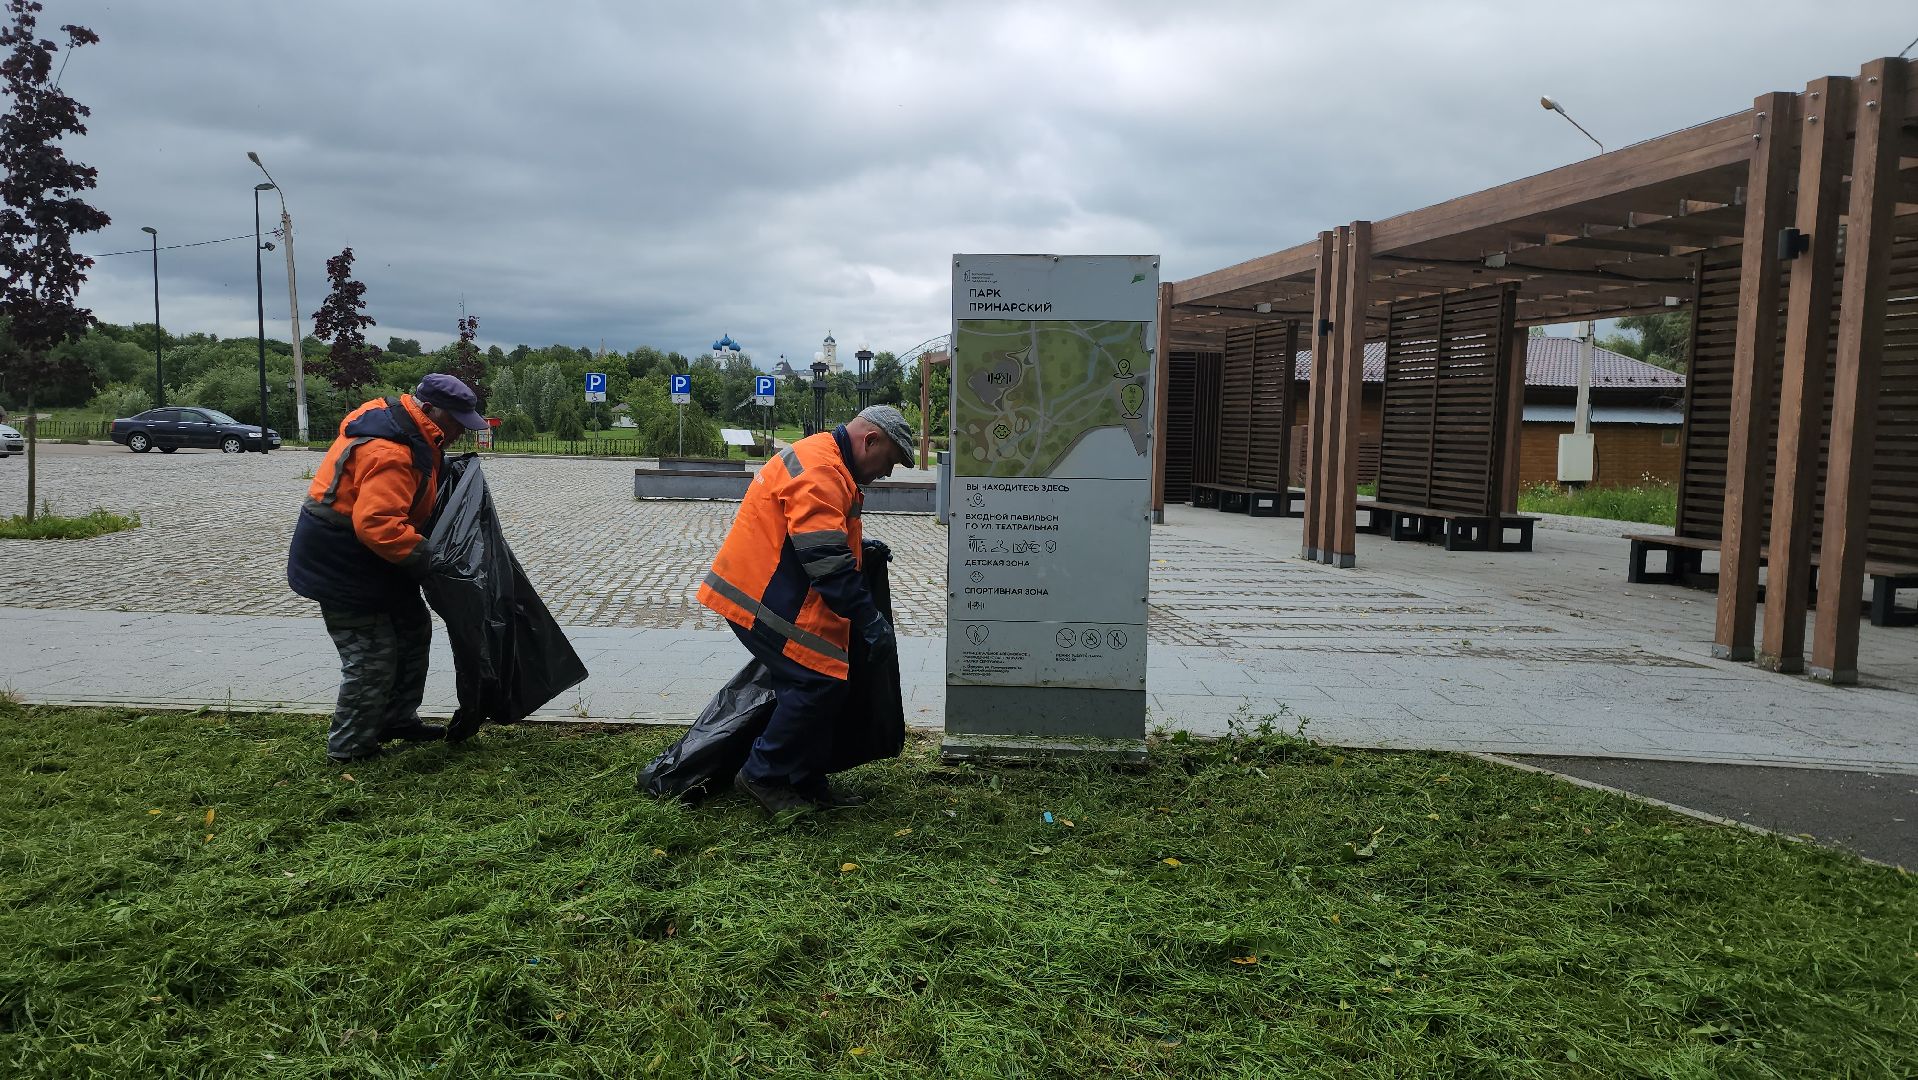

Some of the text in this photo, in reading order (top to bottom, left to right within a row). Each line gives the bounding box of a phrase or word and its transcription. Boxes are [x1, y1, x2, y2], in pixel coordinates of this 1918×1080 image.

[969, 288, 1002, 298] ПАРК
[969, 301, 1052, 313] ПРИНАРСКИЙ
[590, 374, 602, 390] P
[675, 376, 687, 392] P
[759, 378, 772, 394] P
[966, 483, 1070, 493] ВЫ НАХОДИТЕСЬ ЗДЕСЬ
[965, 513, 1059, 522] ВХОДНОЙ ПАВИЛЬОН
[995, 523, 1059, 531] ТЕАТРАЛЬНАЯ
[964, 559, 1005, 567] ДЕТСКАЯ
[964, 587, 1049, 596] СПОРТИВНАЯ ЗОНА
